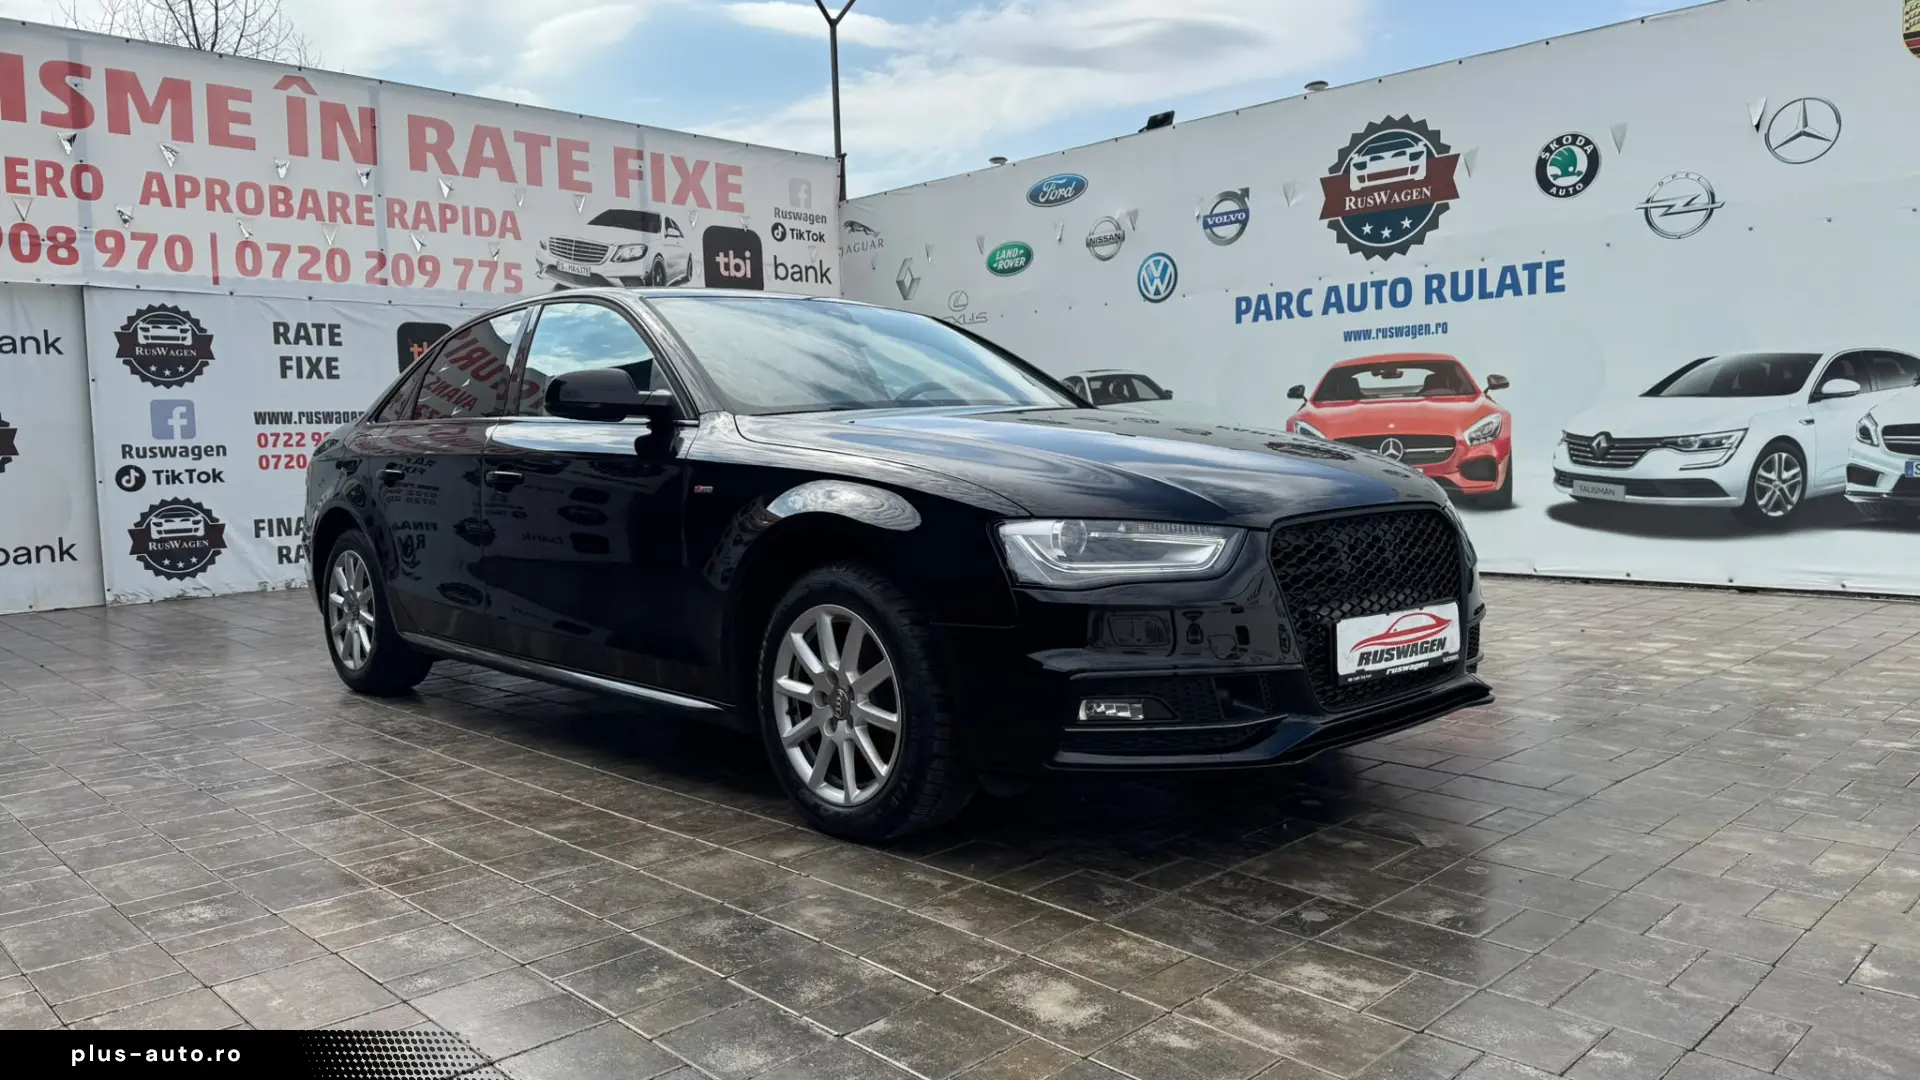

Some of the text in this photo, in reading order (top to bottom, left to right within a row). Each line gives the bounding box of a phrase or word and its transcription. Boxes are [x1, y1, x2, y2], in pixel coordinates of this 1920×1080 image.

[273, 75, 377, 166] ÎN
[407, 115, 593, 194] RATE
[613, 146, 745, 213] FIXE
[1658, 172, 1702, 187] OPEL
[4, 156, 523, 240] ERO APROBARE RAPIDA
[1037, 179, 1077, 203] Ford
[1549, 181, 1584, 197] AUTO
[774, 206, 828, 224] Ruswagen
[1206, 211, 1247, 226] VOLVO
[789, 227, 825, 243] TikTok
[1088, 230, 1122, 246] NISSAN
[839, 238, 884, 257] JAGUAR
[94, 230, 193, 272] 970
[235, 241, 351, 282] 0720
[365, 251, 440, 288] 209
[453, 258, 523, 294] 775
[715, 250, 752, 279] tbi
[774, 256, 832, 285] bank
[1235, 259, 1566, 325] PARC AUTO RULATE
[272, 320, 343, 347] RATE
[1343, 321, 1449, 343] www.ruswagen.ro
[280, 355, 340, 380] FIXE
[257, 432, 331, 449] 0722 9
[121, 443, 228, 460] Ruswagen
[258, 454, 308, 471] 0720
[152, 468, 225, 486] TikTok
[1578, 484, 1616, 497] TALISMAN
[1357, 637, 1447, 667] RUSWAGEN
[1386, 661, 1429, 675] ruswagen
